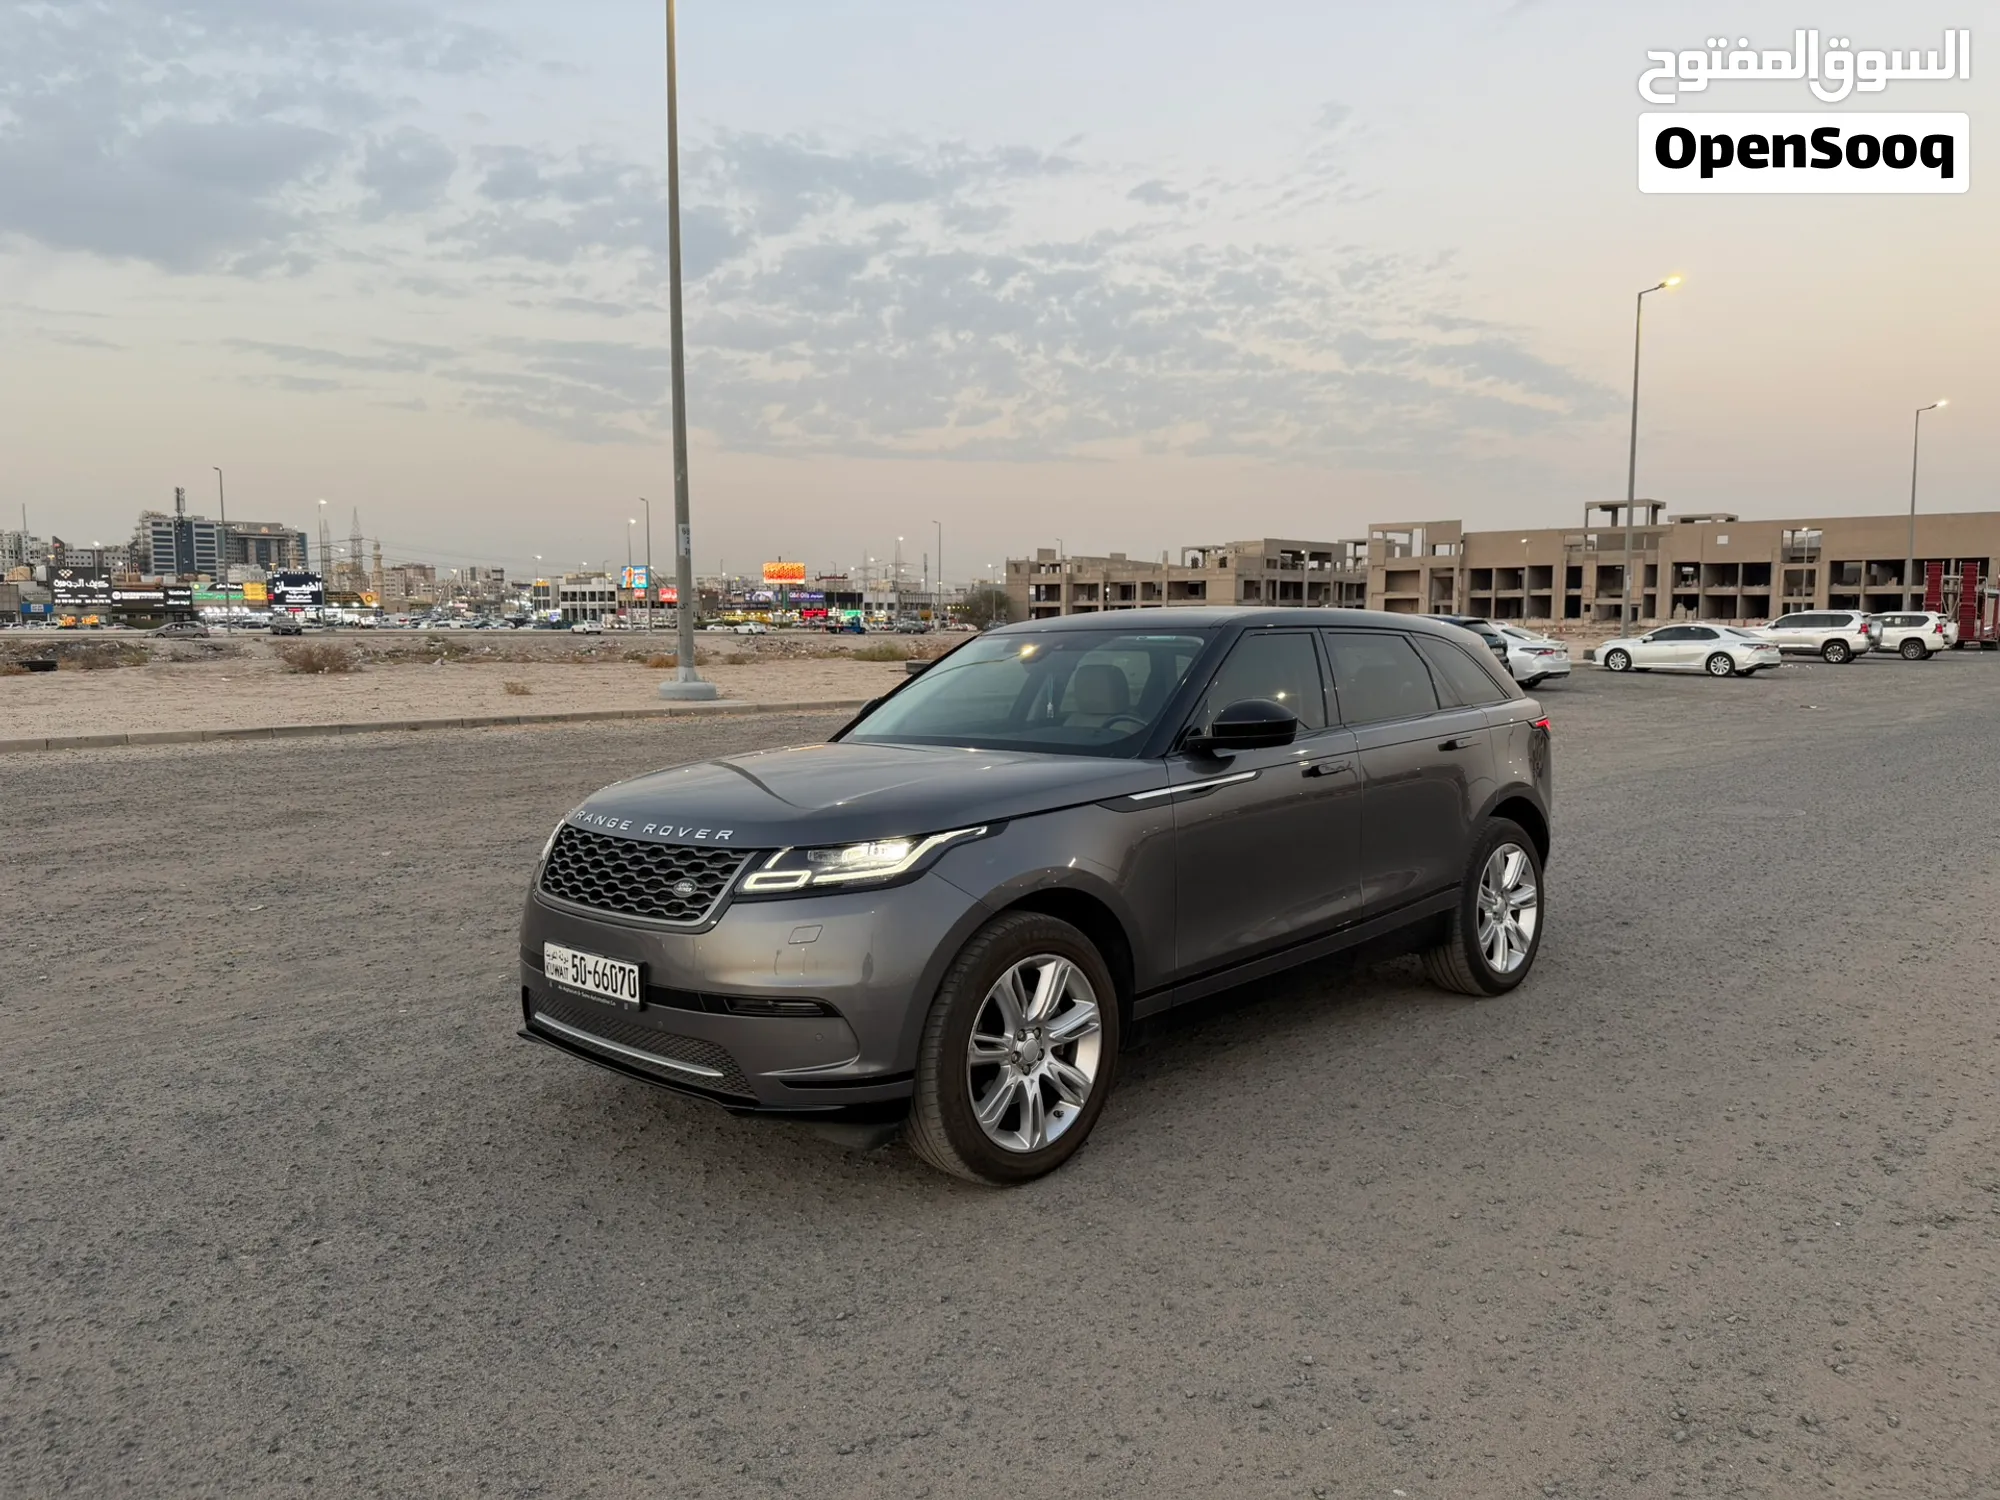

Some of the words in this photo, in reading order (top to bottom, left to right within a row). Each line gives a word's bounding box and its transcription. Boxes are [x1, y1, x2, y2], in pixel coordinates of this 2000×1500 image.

[575, 810, 633, 831] RANGE
[642, 823, 734, 841] ROVER
[546, 961, 569, 981] KUWAIT
[571, 953, 638, 999] 50-66070
